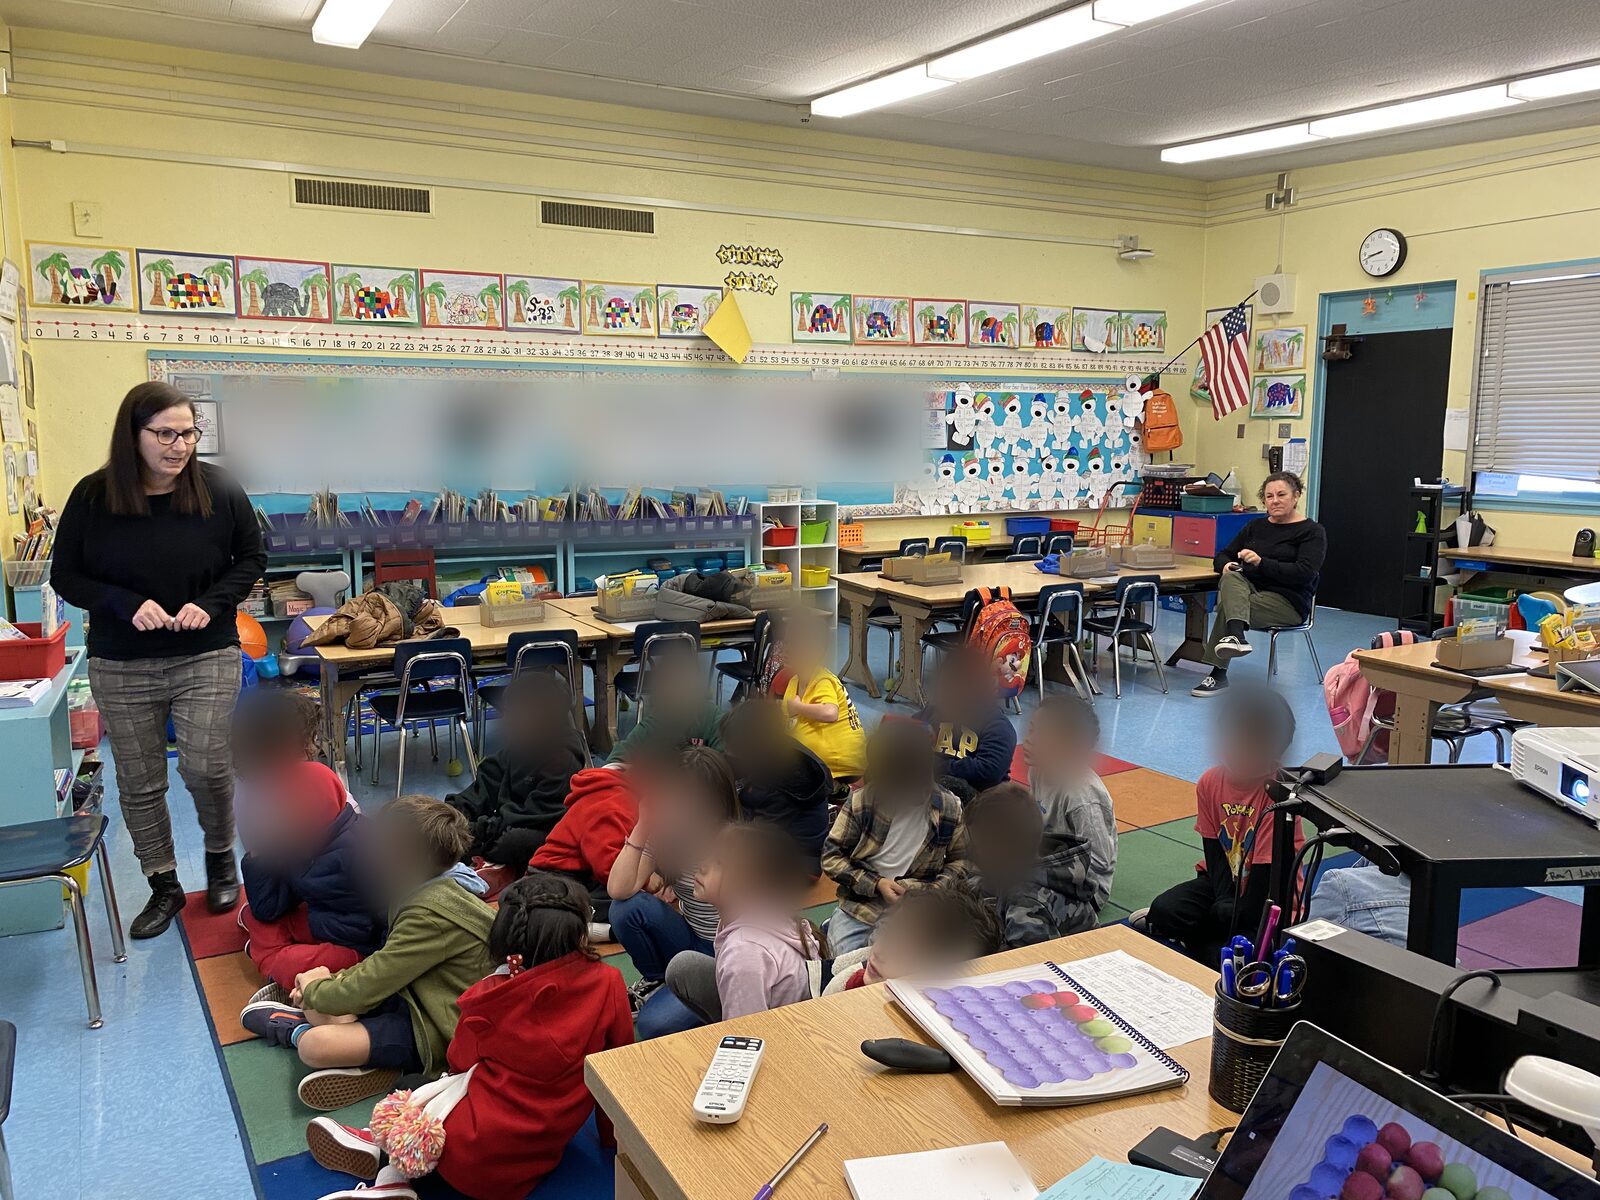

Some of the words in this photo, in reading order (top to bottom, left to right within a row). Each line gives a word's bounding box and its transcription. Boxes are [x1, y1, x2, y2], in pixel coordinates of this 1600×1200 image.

[35, 328, 42, 336] 0
[56, 328, 59, 337] 1
[73, 329, 79, 338] 2
[91, 330, 97, 338] 3
[108, 331, 114, 339] 4
[125, 332, 132, 340] 5
[143, 332, 149, 340] 6
[161, 333, 166, 341] 7
[177, 334, 183, 342] 8
[193, 334, 199, 342] 9
[209, 335, 218, 343] 10
[225, 335, 231, 343] 11
[239, 336, 248, 344] 12
[935, 722, 978, 759] AP
[1534, 763, 1548, 776] EPSON
